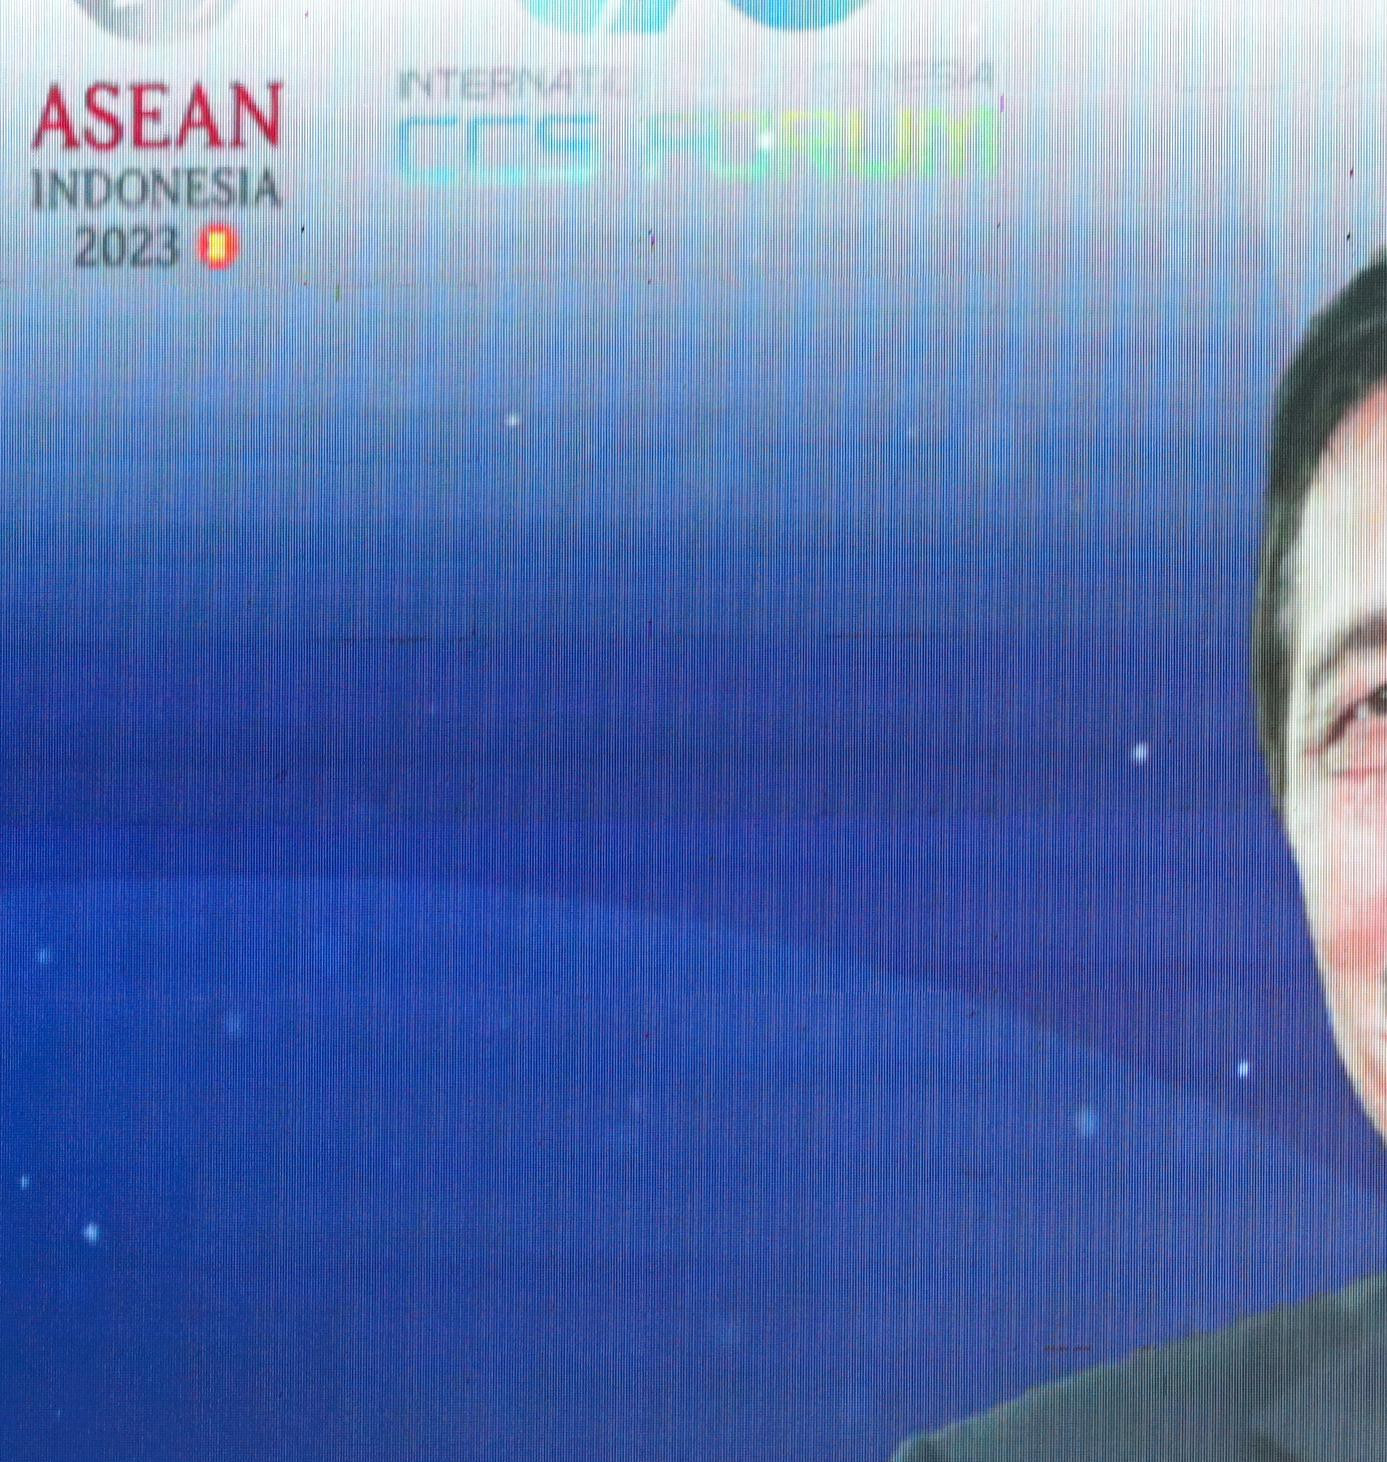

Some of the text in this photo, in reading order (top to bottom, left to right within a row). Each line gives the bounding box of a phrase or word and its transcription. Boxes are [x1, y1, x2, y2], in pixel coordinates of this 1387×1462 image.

[31, 80, 284, 152] ASEAN
[396, 106, 1001, 186] CCS FORUM
[30, 165, 283, 210] INDONESIA
[75, 223, 180, 269] 2023
